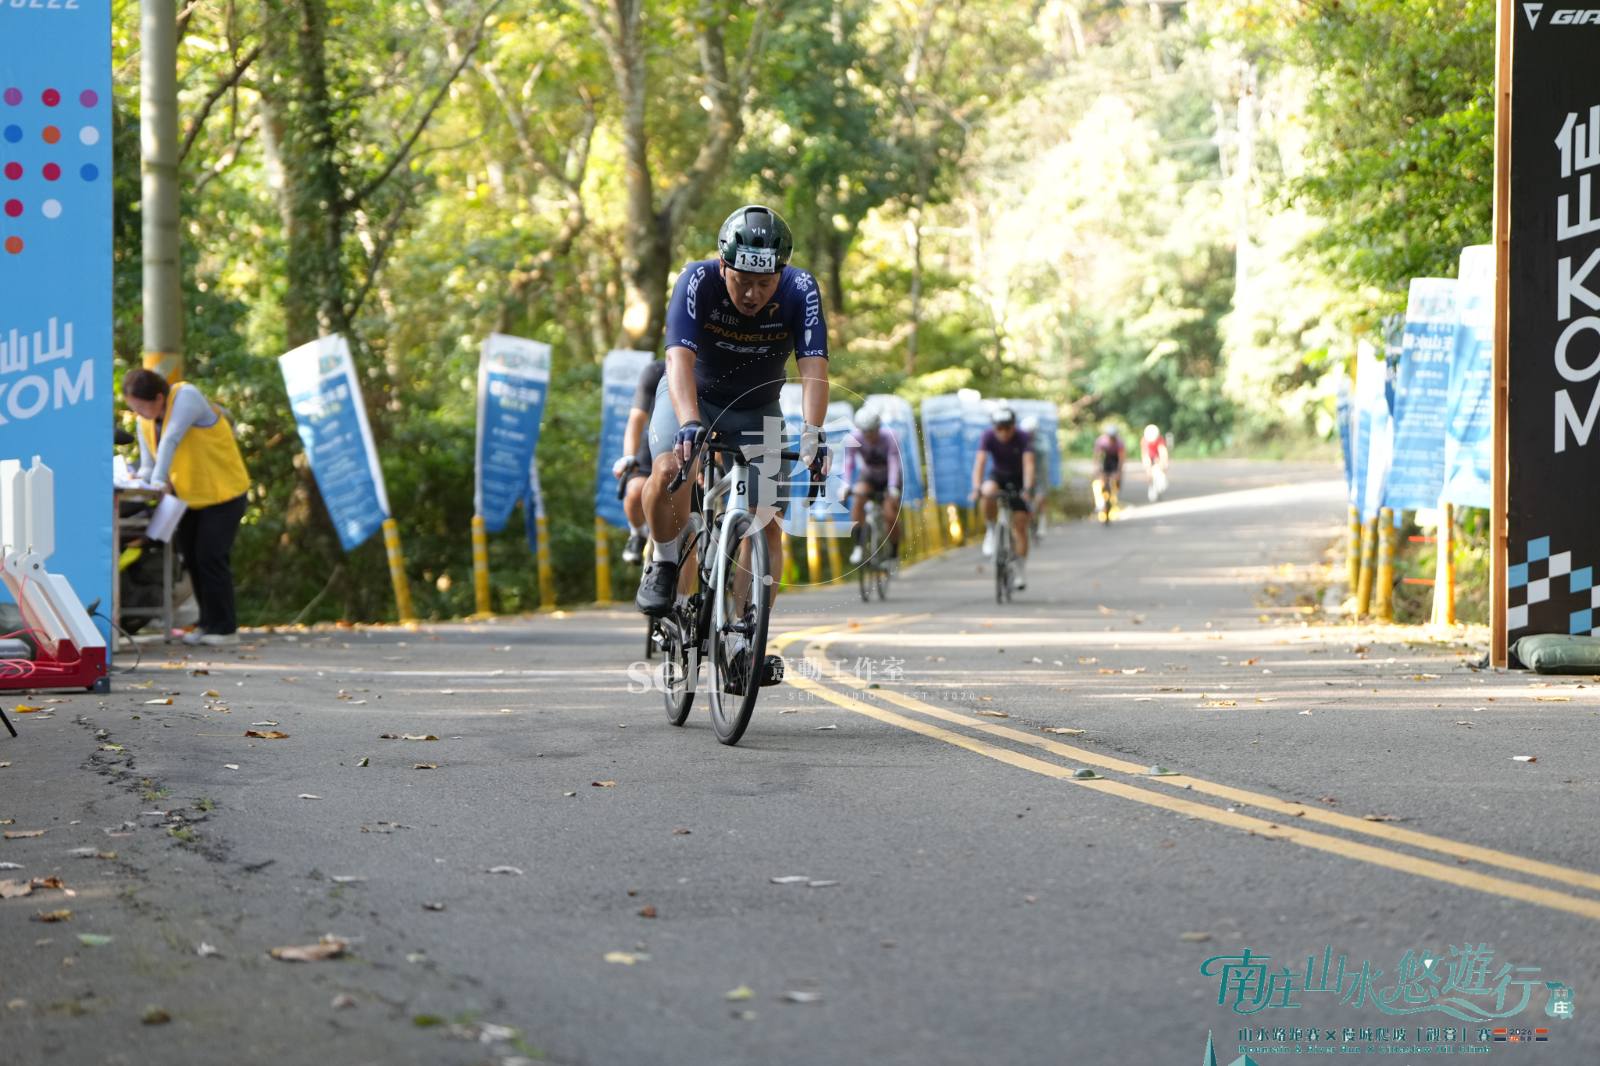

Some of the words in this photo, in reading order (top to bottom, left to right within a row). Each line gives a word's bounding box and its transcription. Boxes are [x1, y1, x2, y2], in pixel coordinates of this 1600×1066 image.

[805, 291, 819, 328] UBS
[703, 322, 788, 343] PINARELLO
[0, 358, 95, 426] OM
